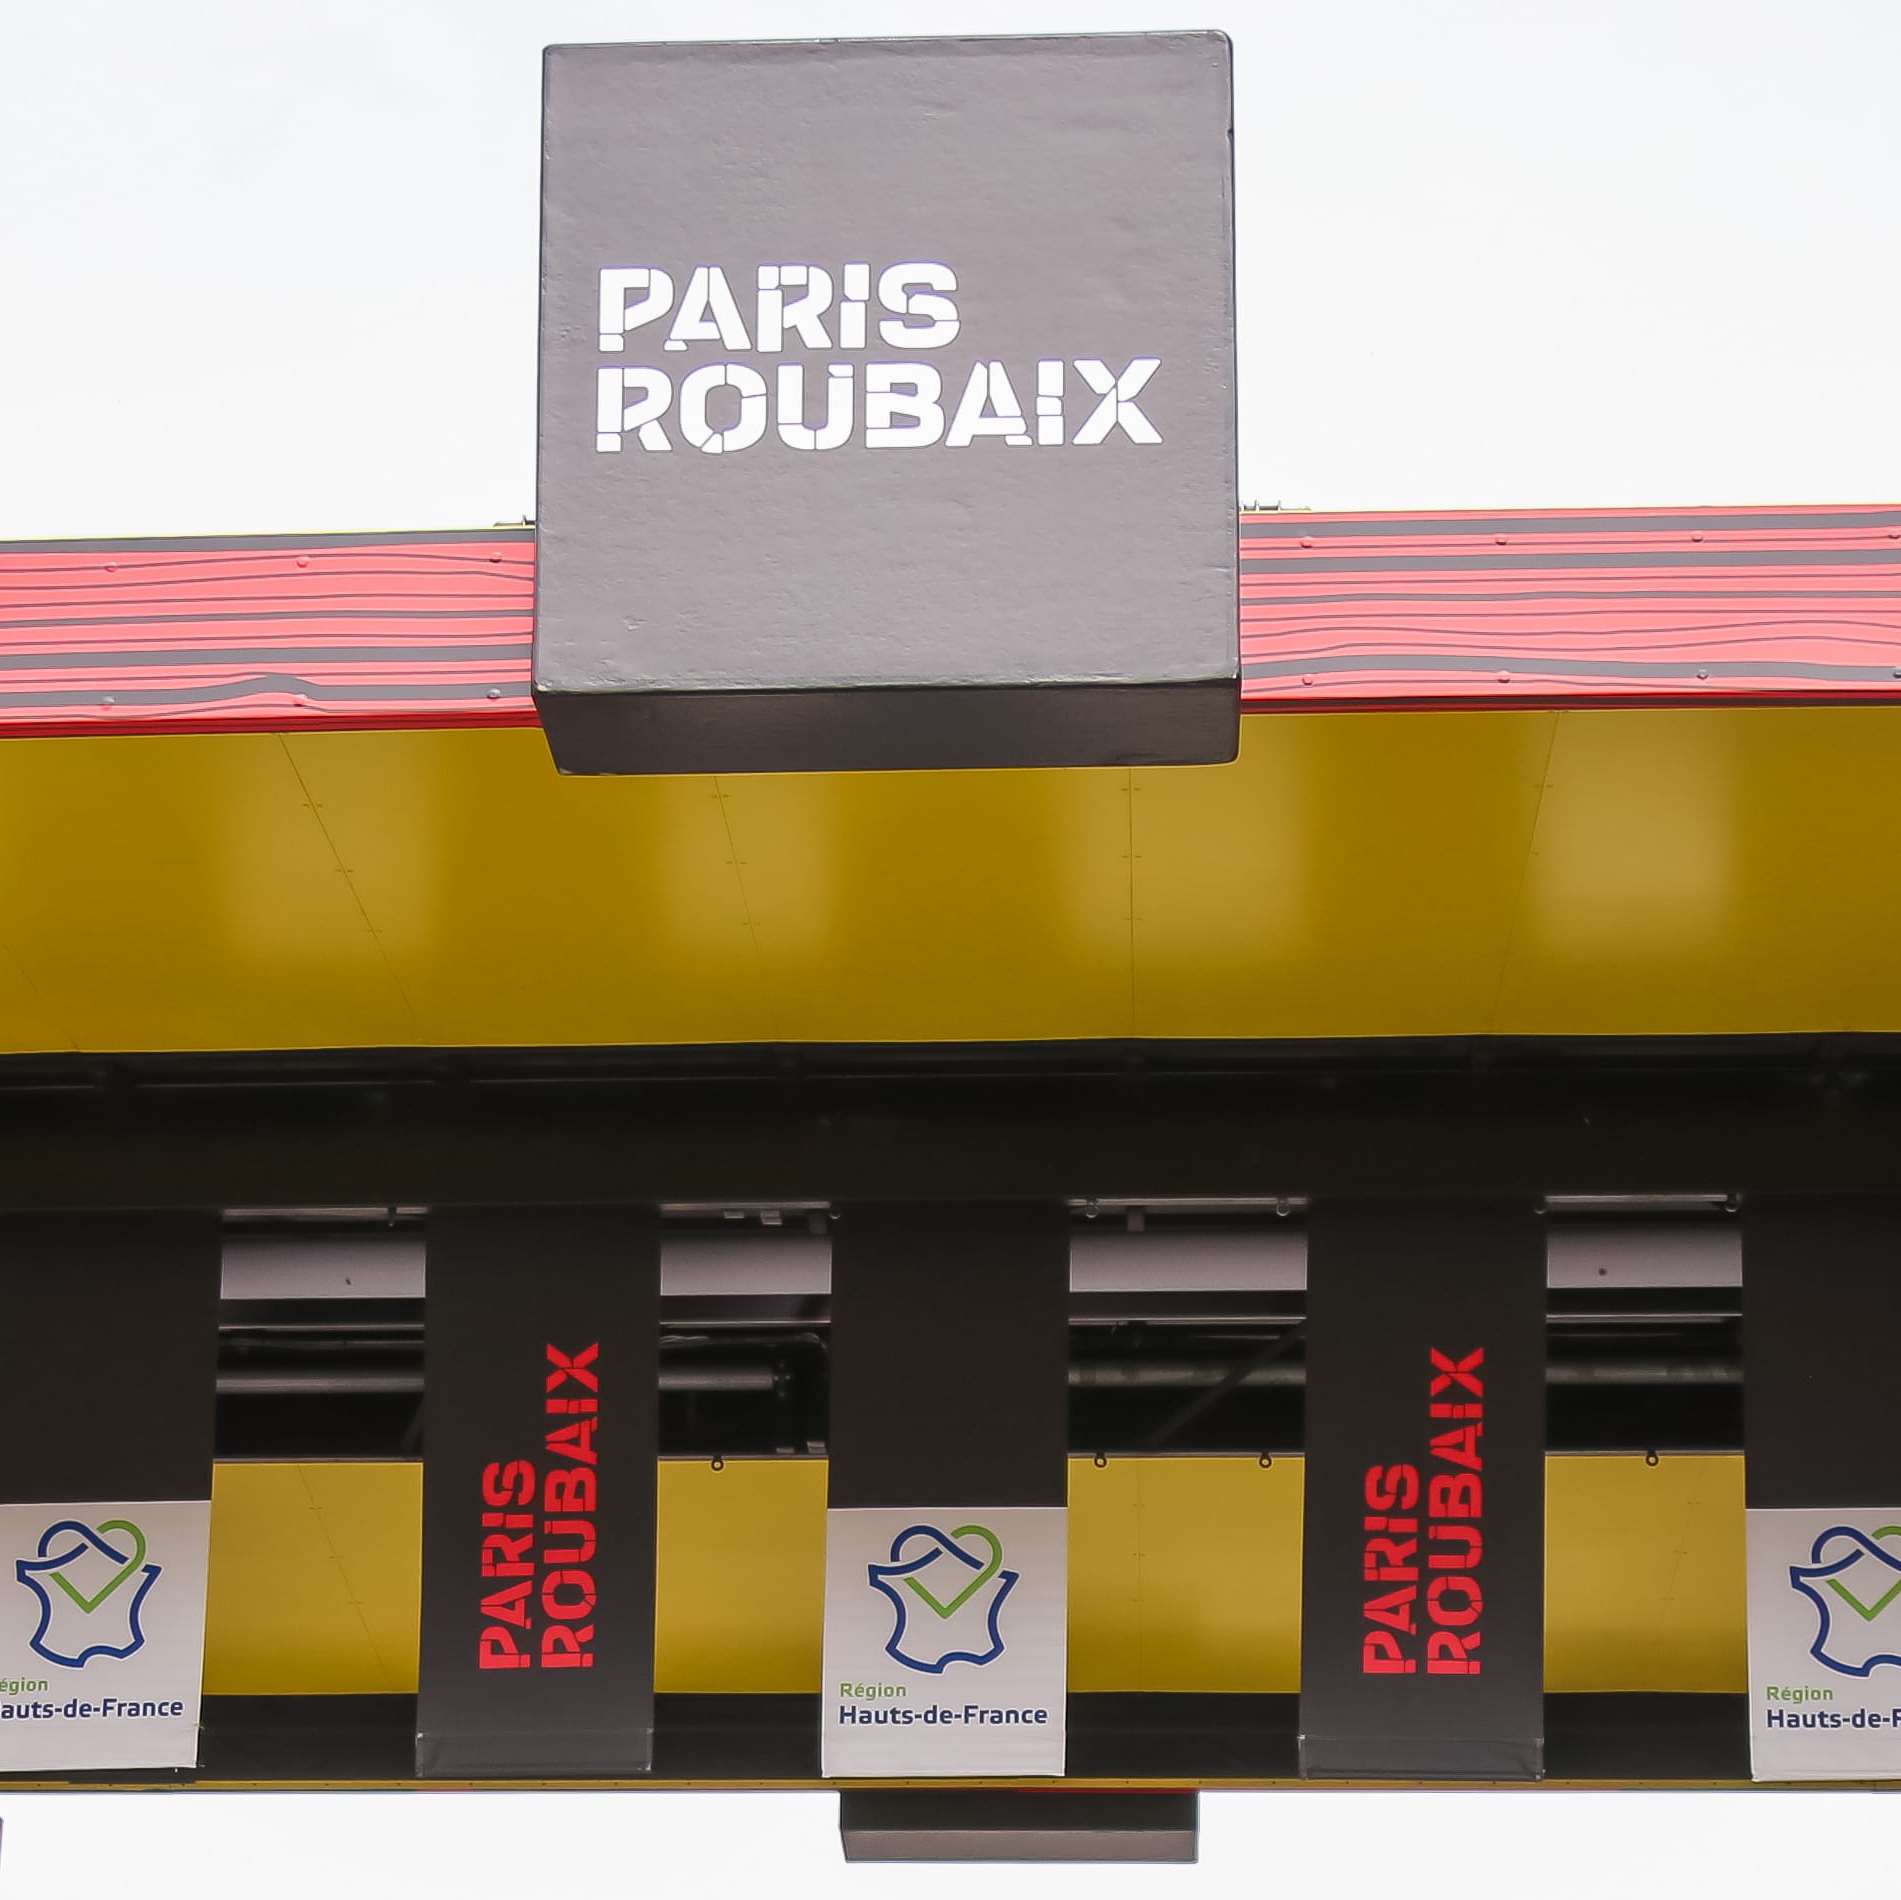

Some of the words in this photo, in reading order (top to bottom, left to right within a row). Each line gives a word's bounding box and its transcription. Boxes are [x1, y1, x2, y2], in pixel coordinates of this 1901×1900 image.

[597, 261, 961, 352] PARIS
[596, 357, 1163, 454] ROUBAIX
[541, 1341, 601, 1669] ROUBAIX
[1426, 1346, 1485, 1676] ROUBAIX
[478, 1458, 536, 1670] PARIS
[1362, 1463, 1420, 1675] PARIS
[838, 1703, 1049, 1727] Hauts-de-France
[839, 1681, 907, 1702] Région
[1765, 1685, 1834, 1705] Région
